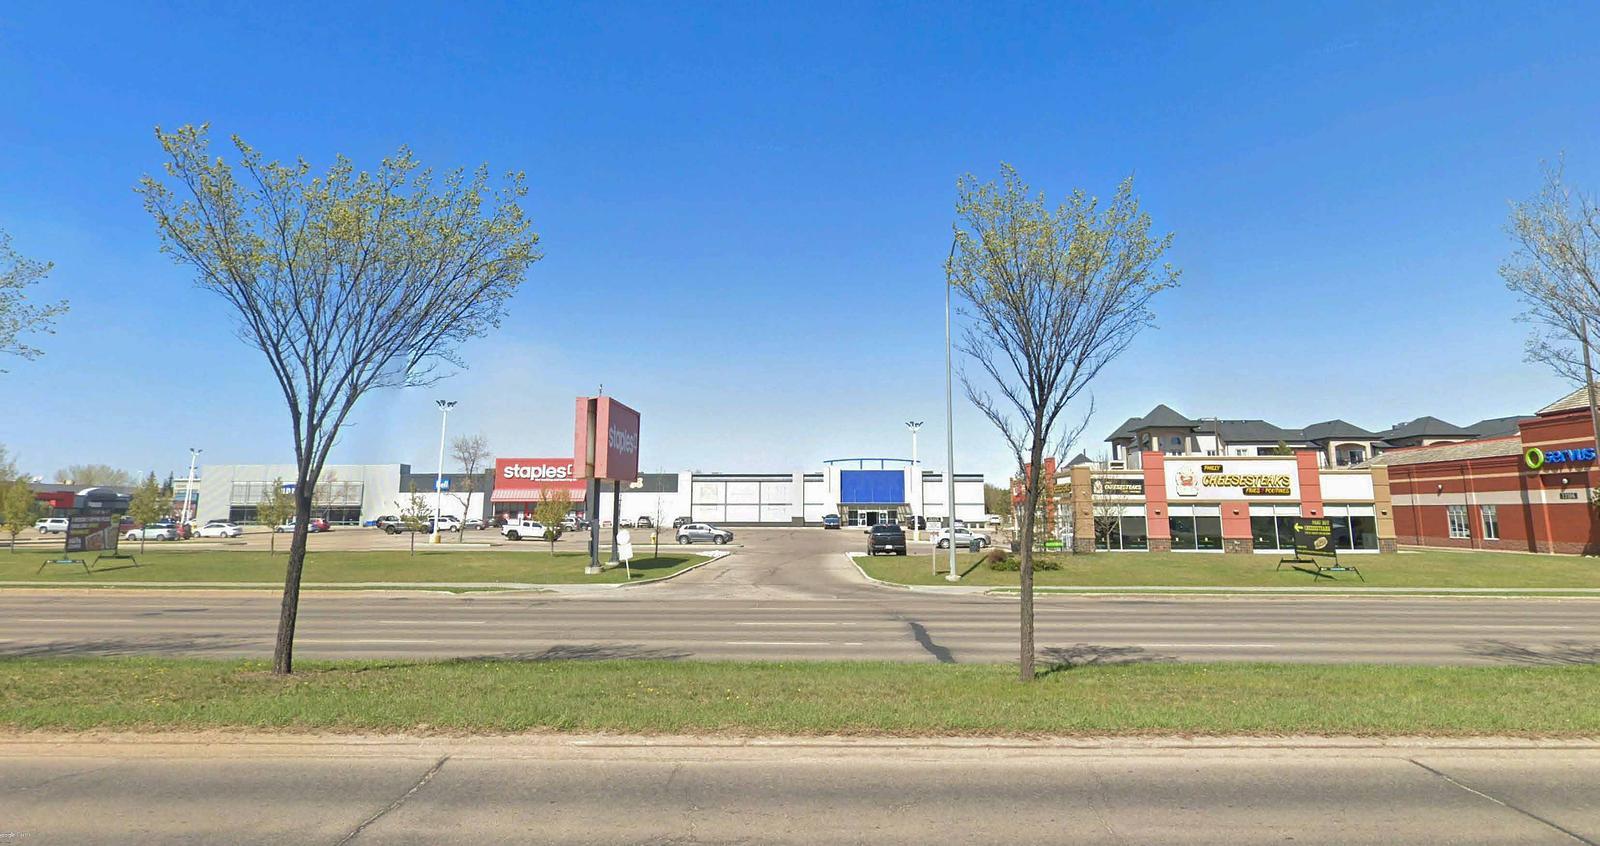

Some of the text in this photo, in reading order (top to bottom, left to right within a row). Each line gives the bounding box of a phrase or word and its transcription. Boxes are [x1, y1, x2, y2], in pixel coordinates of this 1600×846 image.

[609, 424, 633, 455] staples
[1545, 448, 1596, 463] servus
[503, 464, 567, 480] staples
[1202, 474, 1291, 487] CHEESESTEAKS
